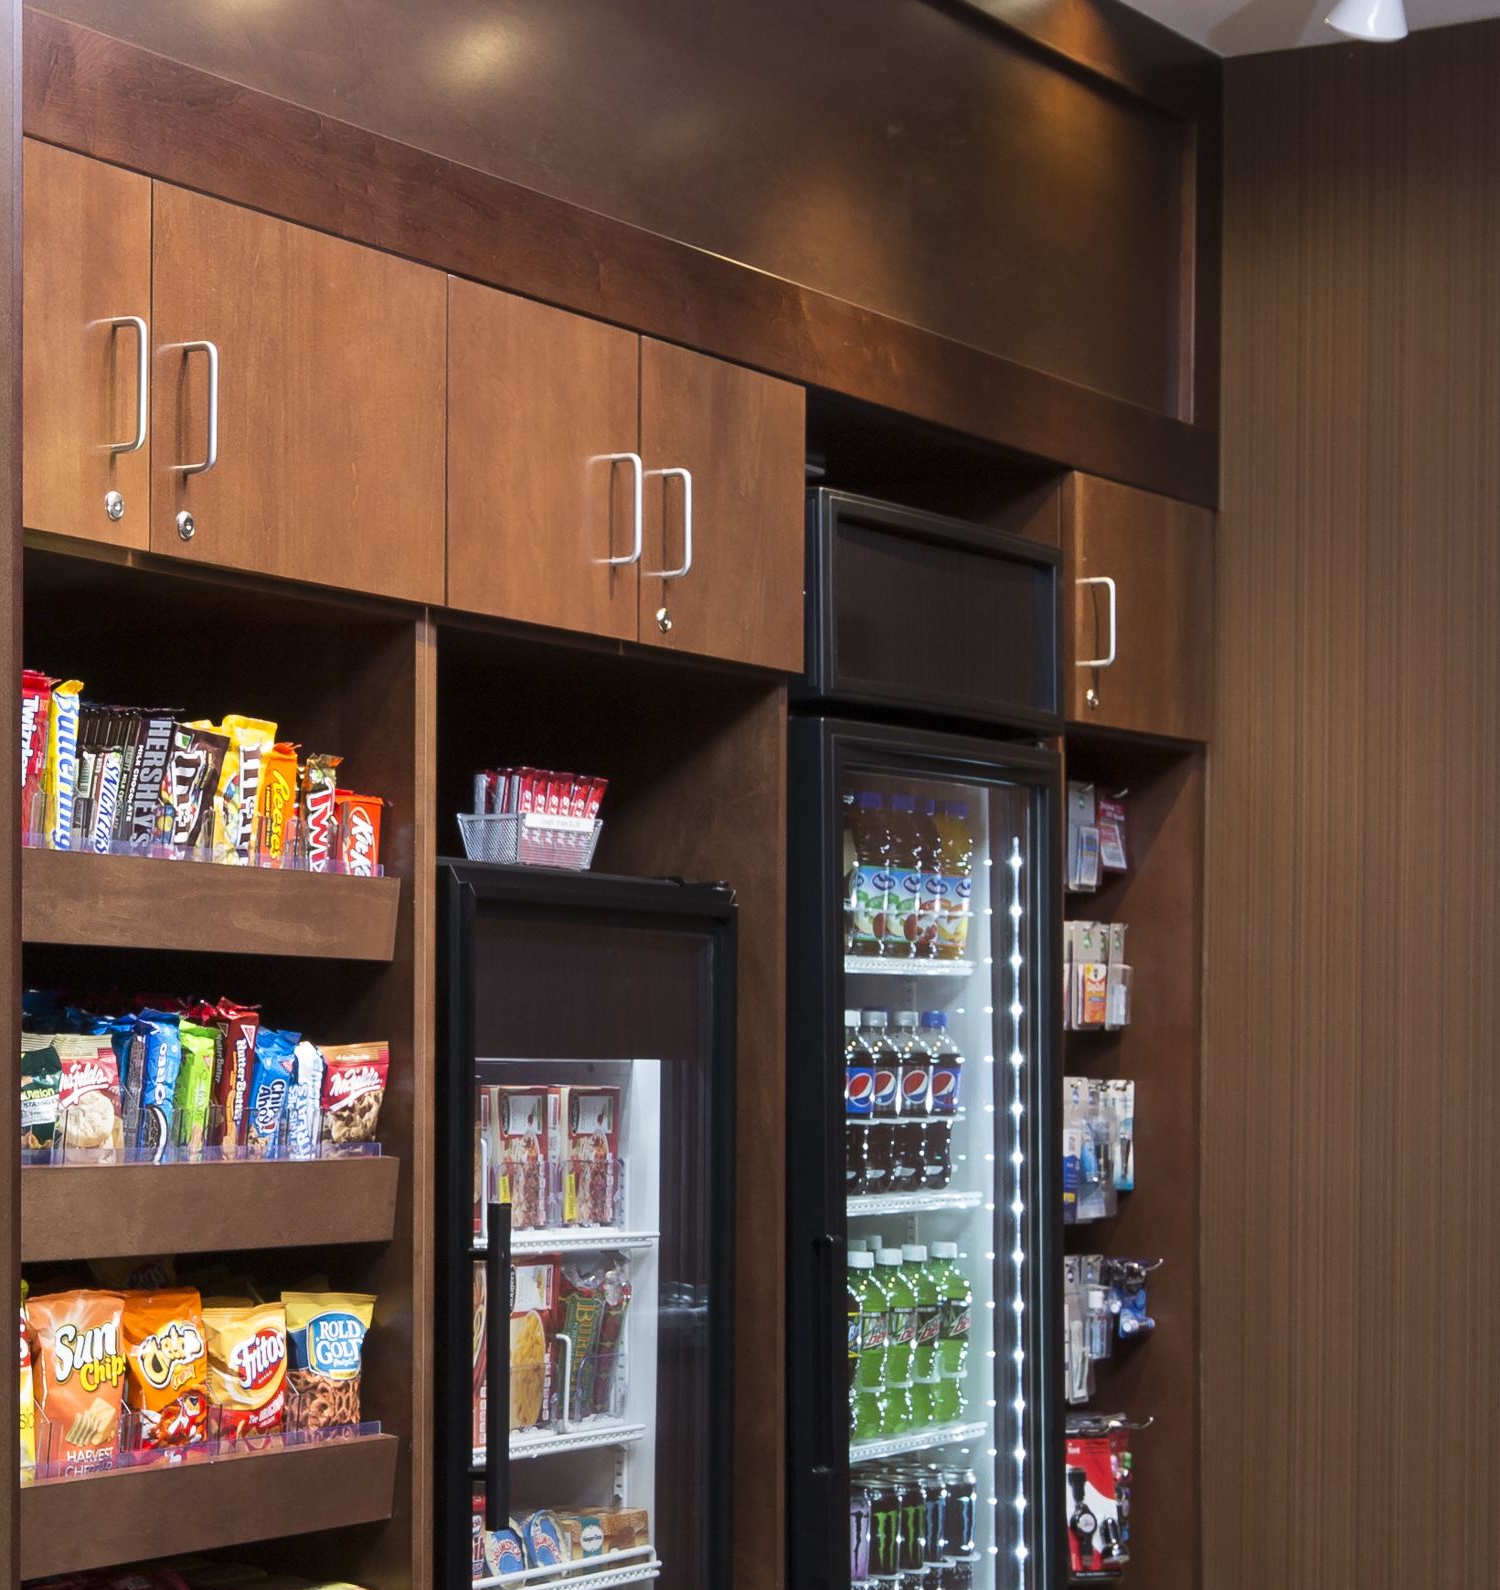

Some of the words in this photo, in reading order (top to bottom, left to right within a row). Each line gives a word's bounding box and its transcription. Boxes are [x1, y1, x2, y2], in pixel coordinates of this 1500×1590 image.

[95, 759, 120, 854] SNICKERS
[55, 1321, 119, 1383] Sun
[319, 1319, 362, 1341] ROLD
[229, 1332, 285, 1389] Fritos
[67, 1447, 114, 1463] HARVEST
